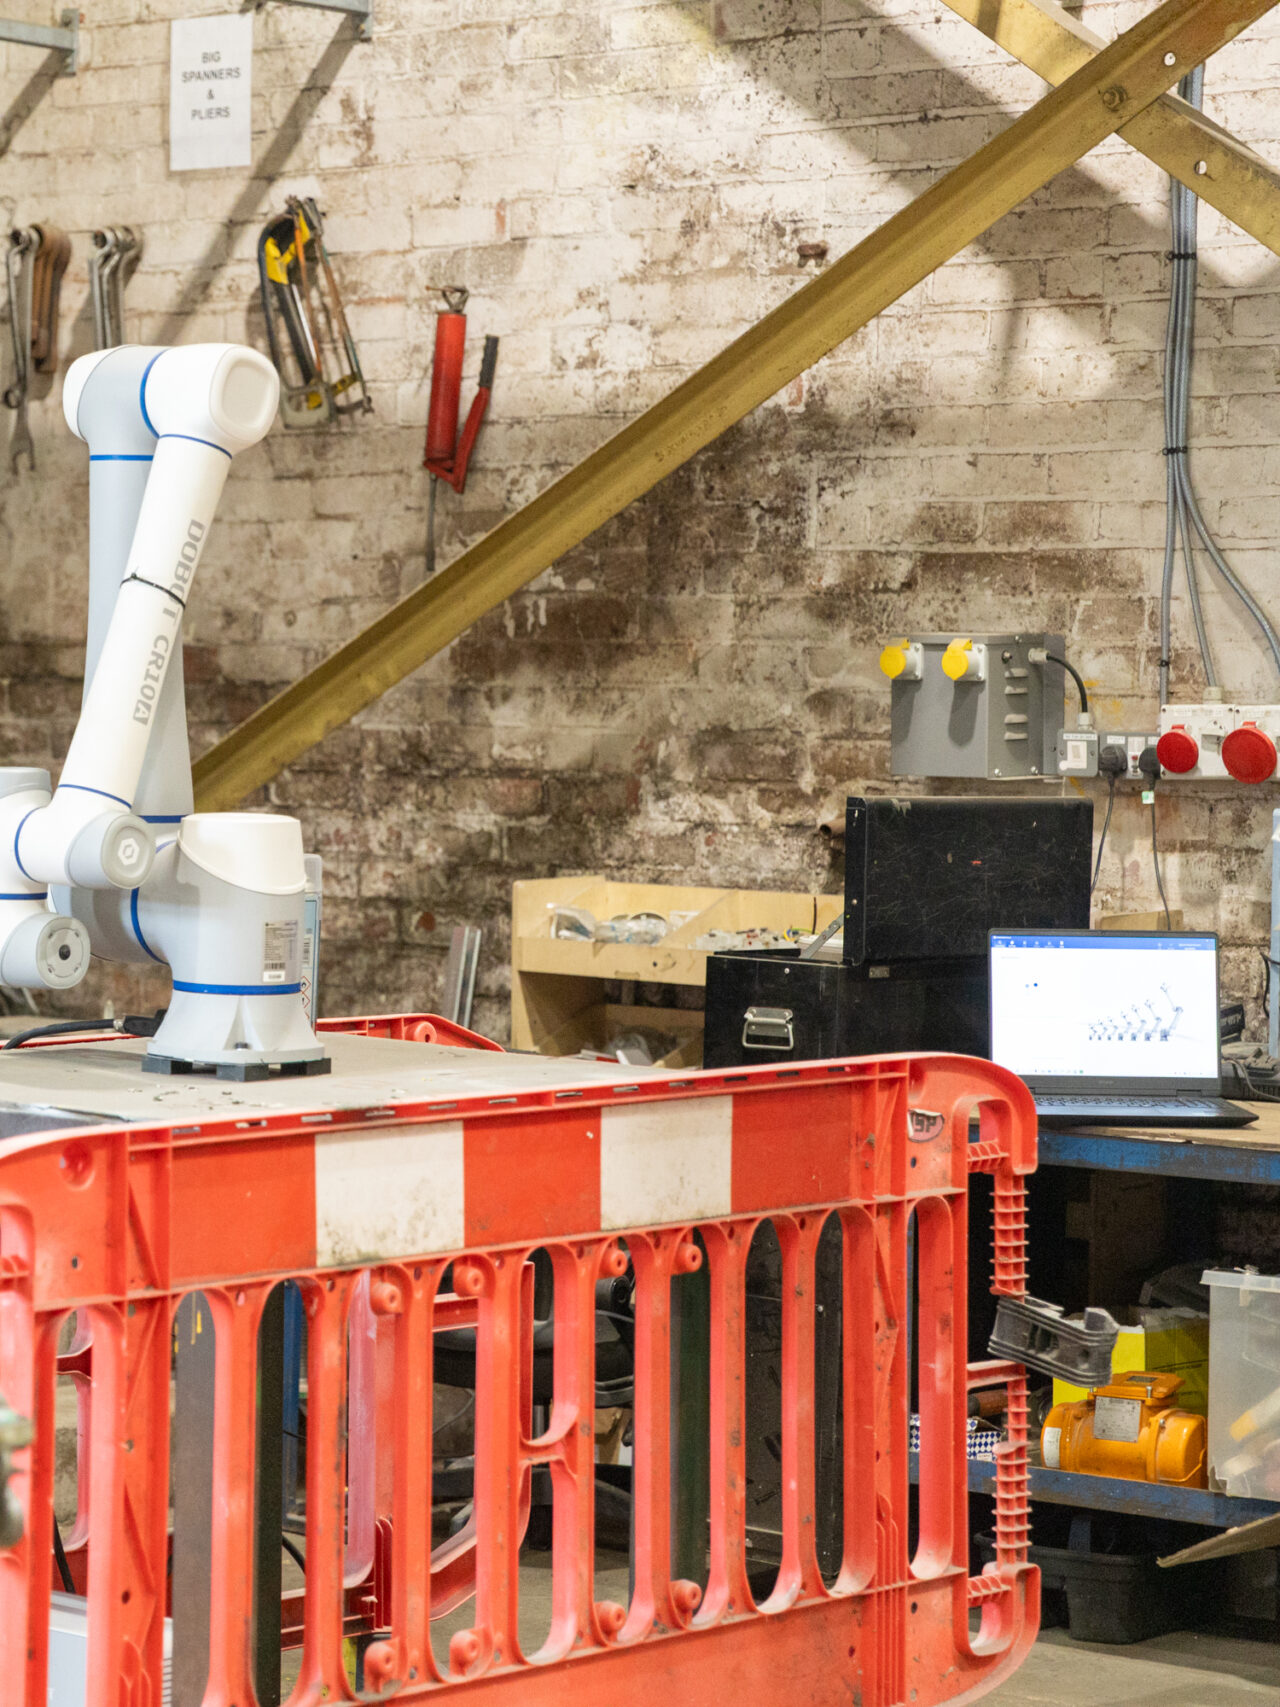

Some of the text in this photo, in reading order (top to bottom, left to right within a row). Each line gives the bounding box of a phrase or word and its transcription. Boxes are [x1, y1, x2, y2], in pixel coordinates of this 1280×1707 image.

[201, 51, 221, 64] BIG
[181, 67, 241, 83] SPANNERS
[206, 88, 215, 100] &
[191, 106, 231, 120] PLIERS
[133, 634, 169, 726] CR10A
